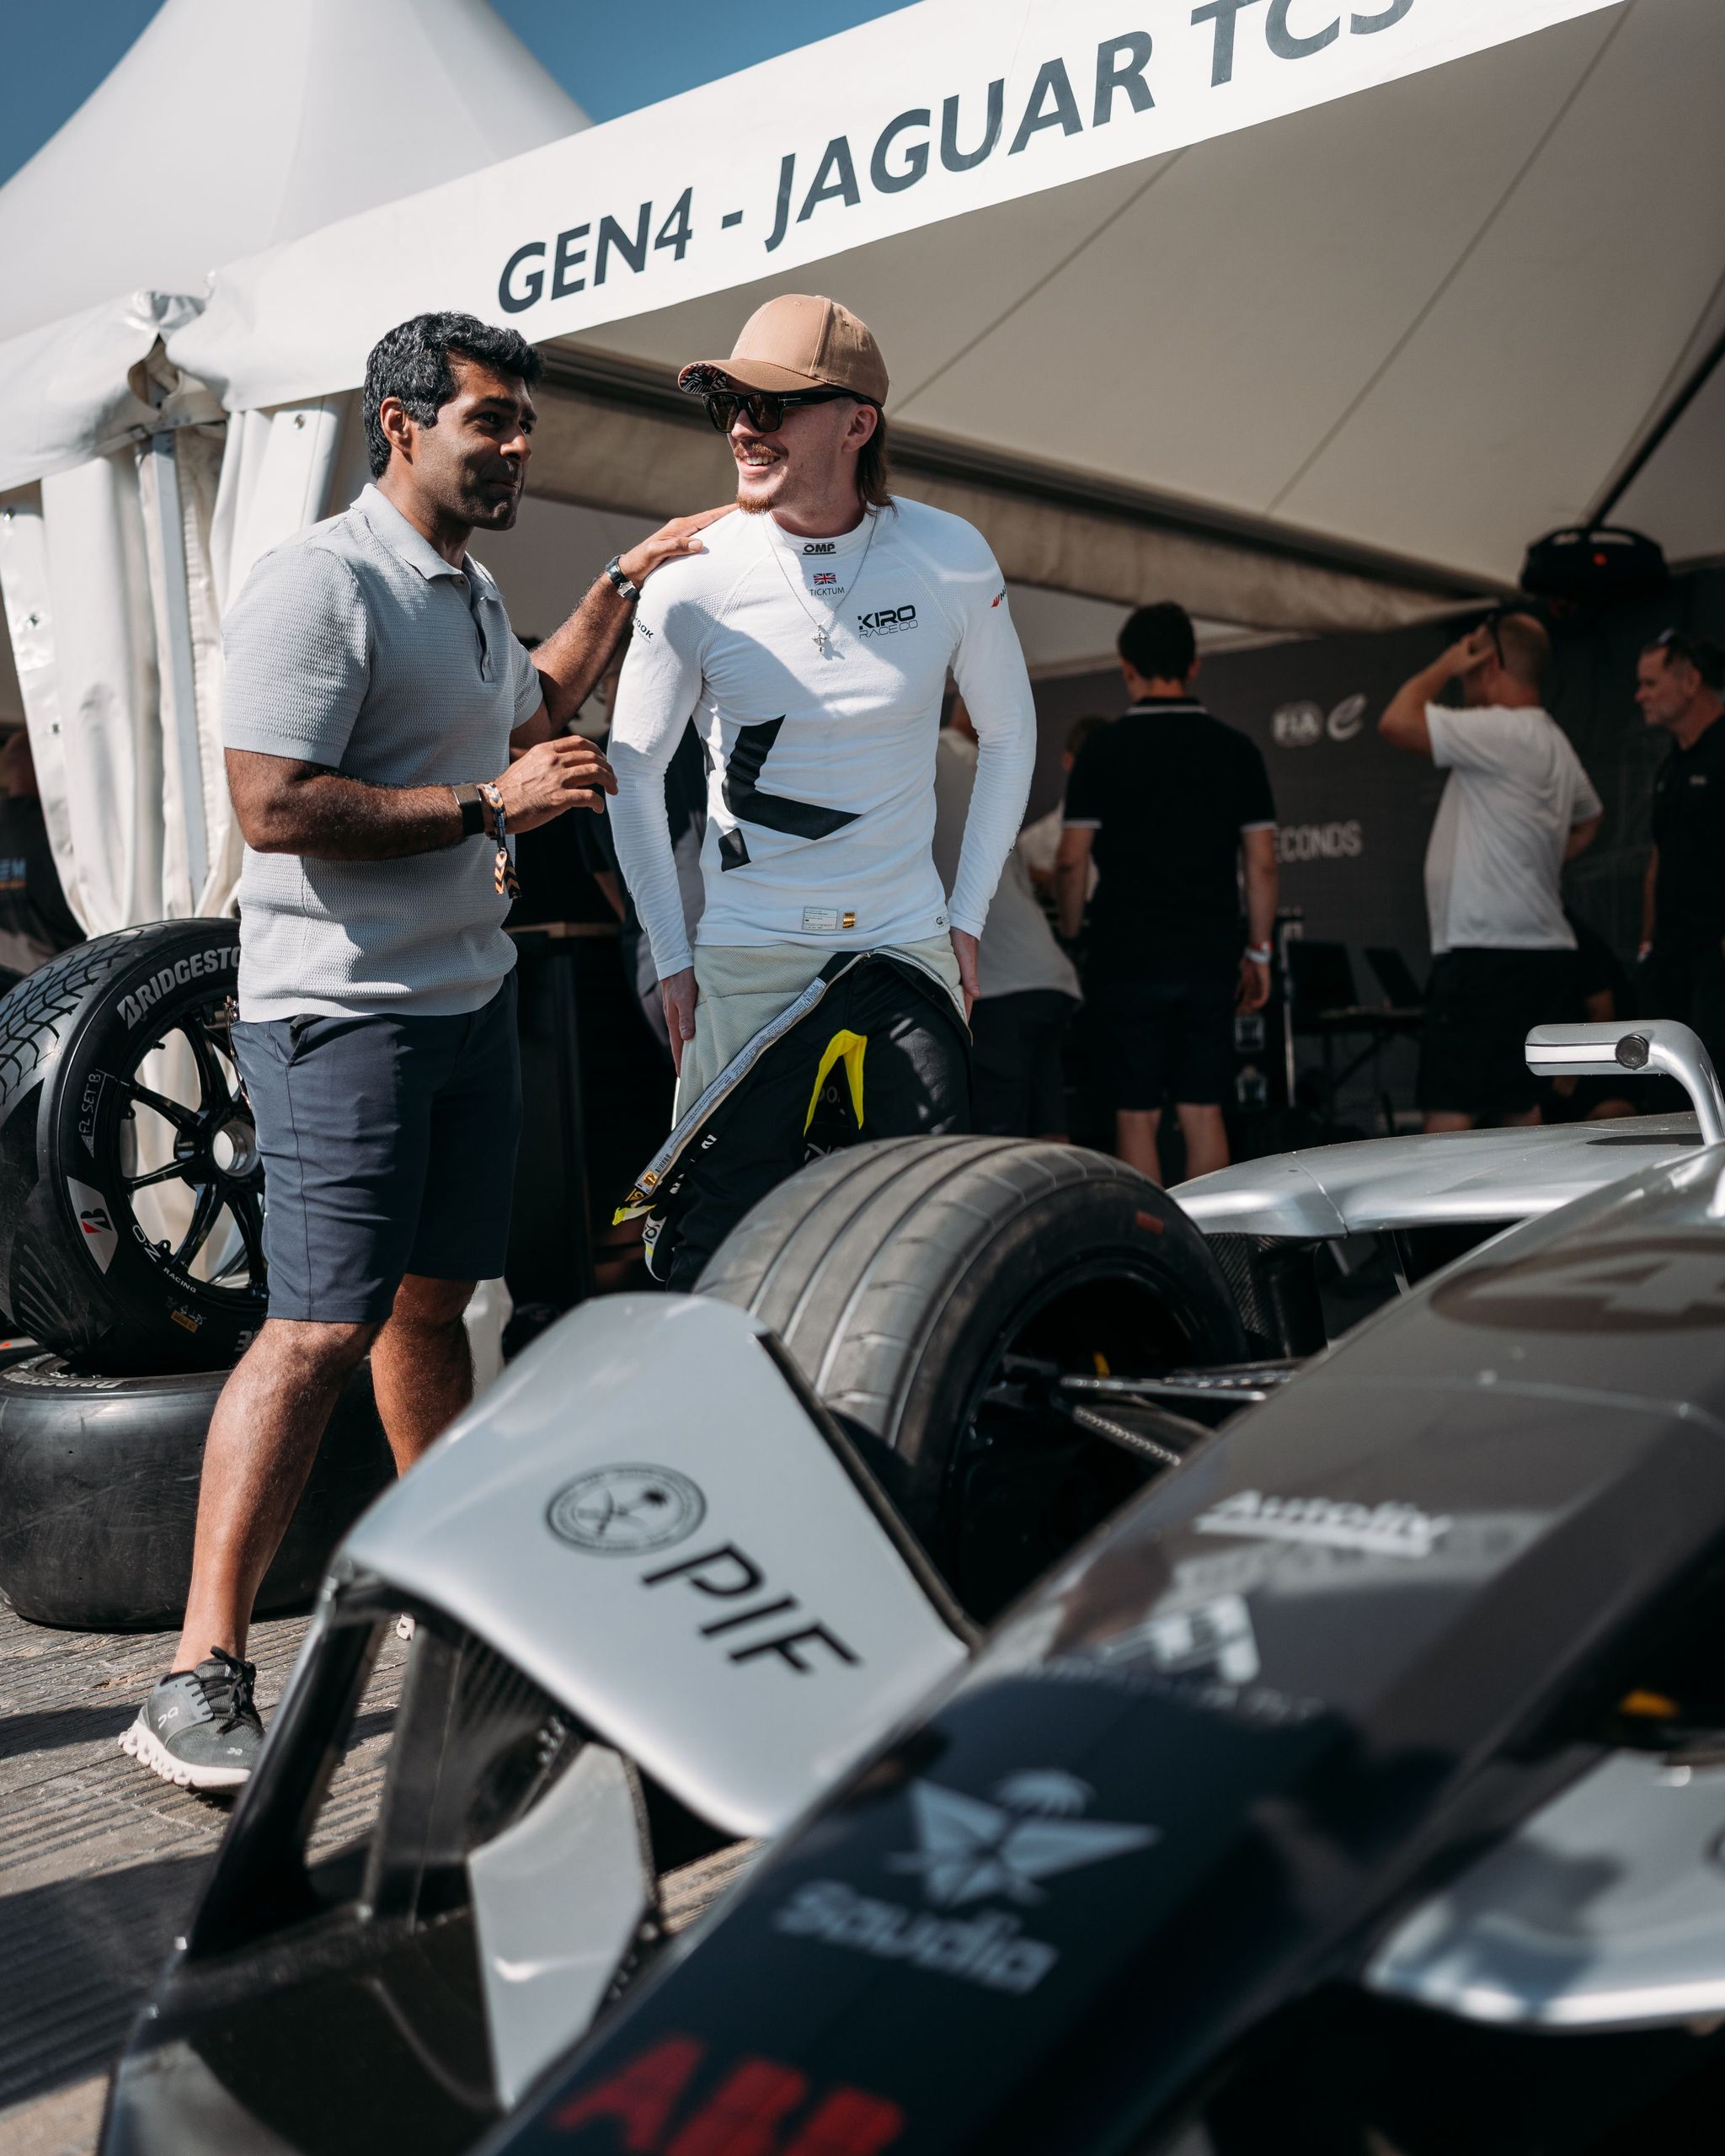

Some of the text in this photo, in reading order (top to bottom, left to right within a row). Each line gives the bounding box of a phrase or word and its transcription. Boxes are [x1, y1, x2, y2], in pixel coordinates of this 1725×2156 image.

[499, 187, 694, 314] GEN4
[765, 30, 1156, 253] JAGUAR
[803, 543, 836, 552] OMP
[810, 587, 845, 597] TICKTUM
[857, 604, 916, 630] KIRO
[163, 1267, 196, 1294] RACING
[641, 1541, 862, 1673] PIF
[774, 1880, 1060, 1994] Saudia
